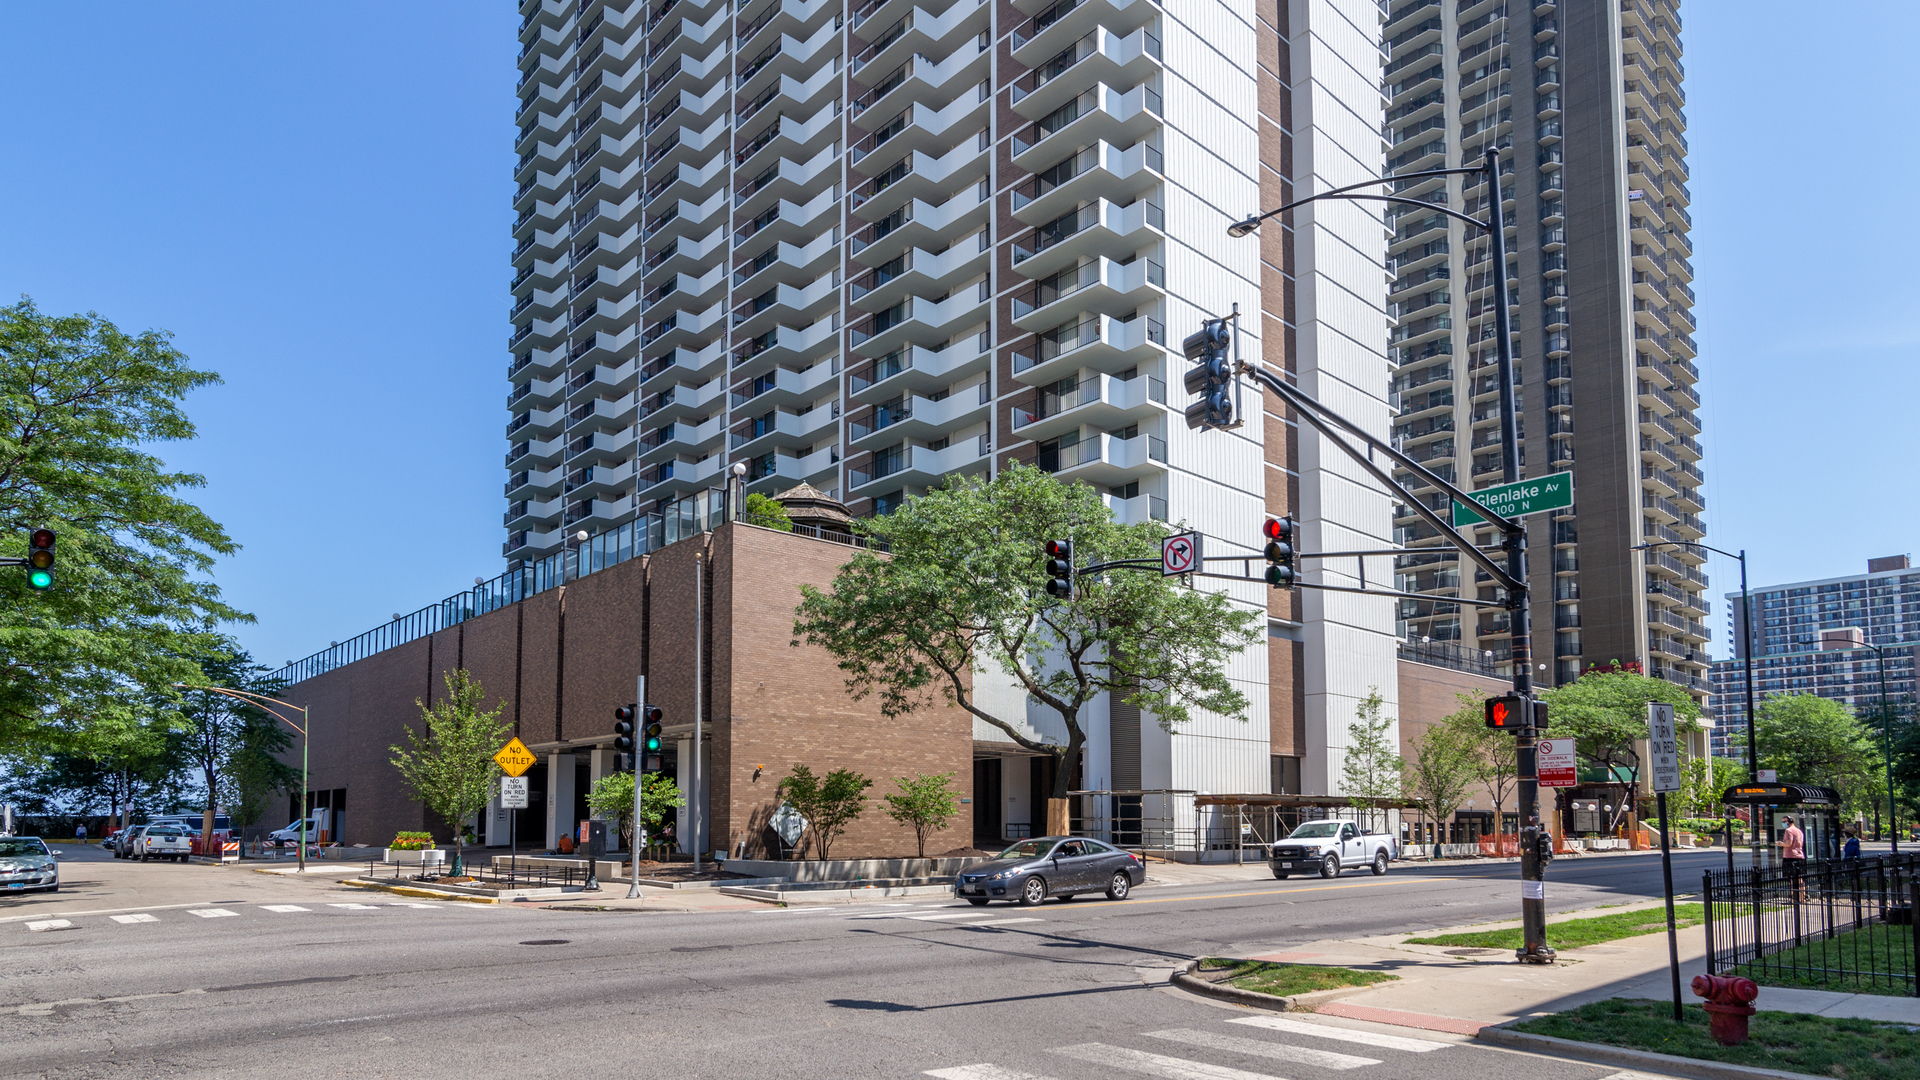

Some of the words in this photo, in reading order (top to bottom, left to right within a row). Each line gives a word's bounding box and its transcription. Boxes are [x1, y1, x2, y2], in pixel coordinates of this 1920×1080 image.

[1476, 486, 1539, 506] Glenlake
[1545, 484, 1559, 493] Av
[1522, 501, 1530, 511] N
[1656, 710, 1666, 722] NO
[1655, 726, 1670, 738] TURN
[1654, 742, 1661, 754] ON
[1664, 742, 1674, 754] RED
[500, 756, 530, 764] OUTLET
